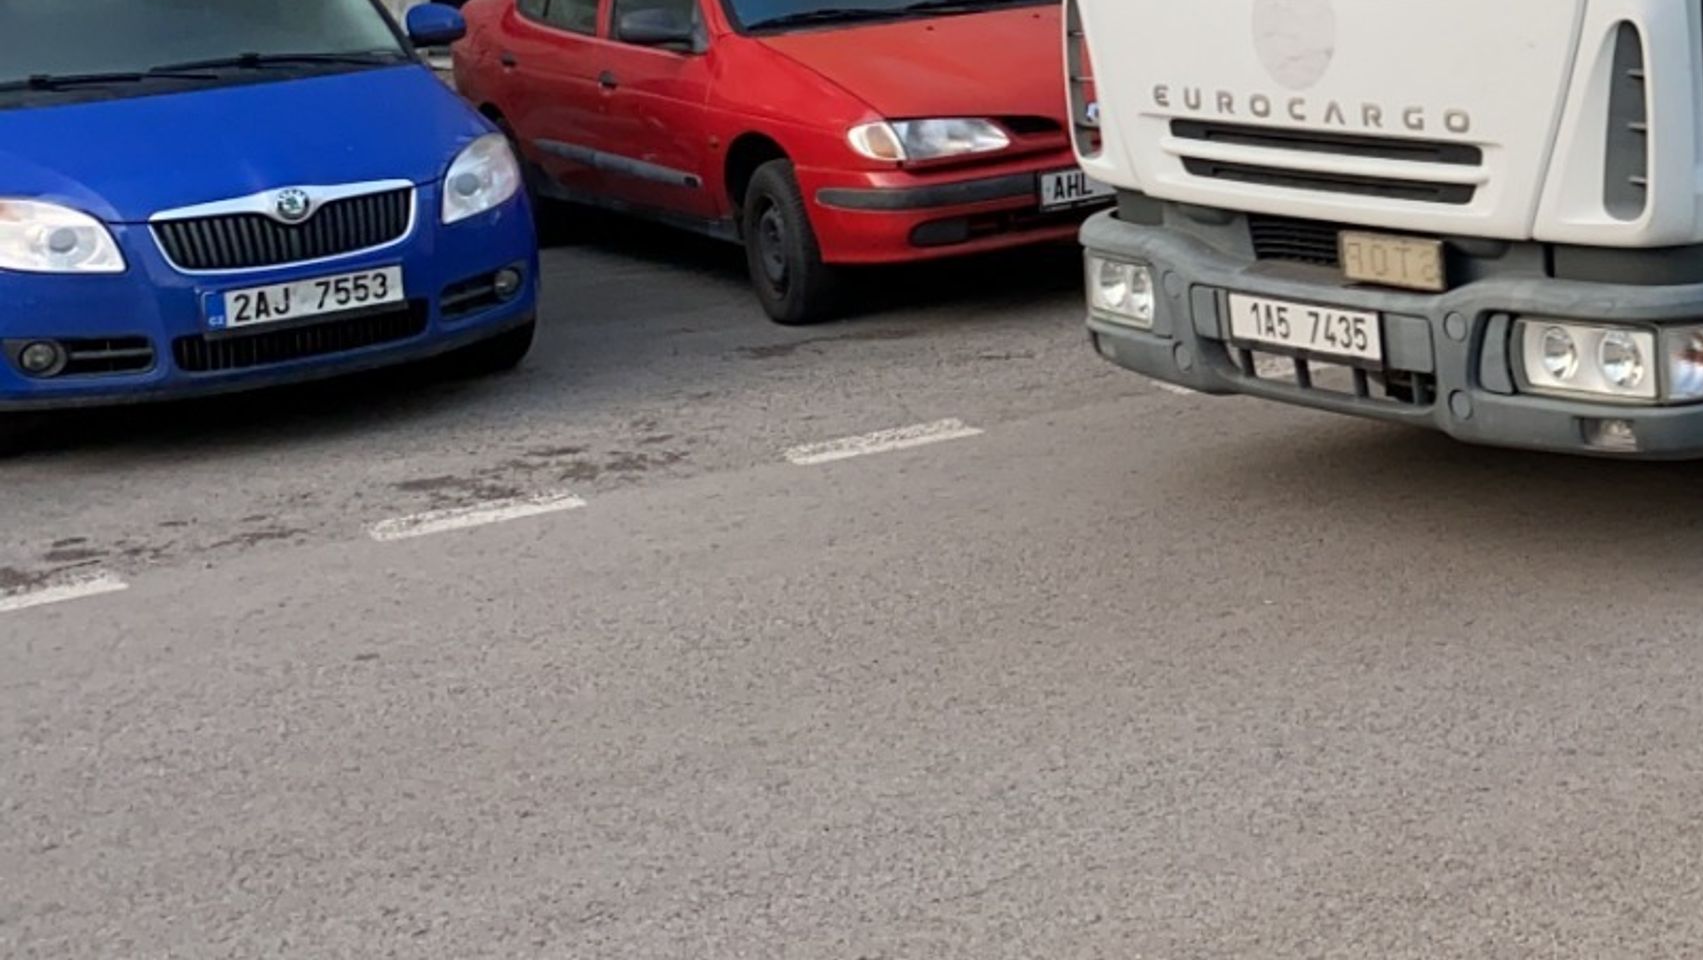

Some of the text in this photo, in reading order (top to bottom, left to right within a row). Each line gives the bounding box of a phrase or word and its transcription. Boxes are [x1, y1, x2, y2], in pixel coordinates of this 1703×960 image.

[1152, 84, 1471, 134] EUROCARGO
[1054, 172, 1093, 200] AHL
[233, 288, 291, 323] 2AJ
[315, 272, 389, 311] 7553
[1250, 302, 1368, 351] 1A5 7435
